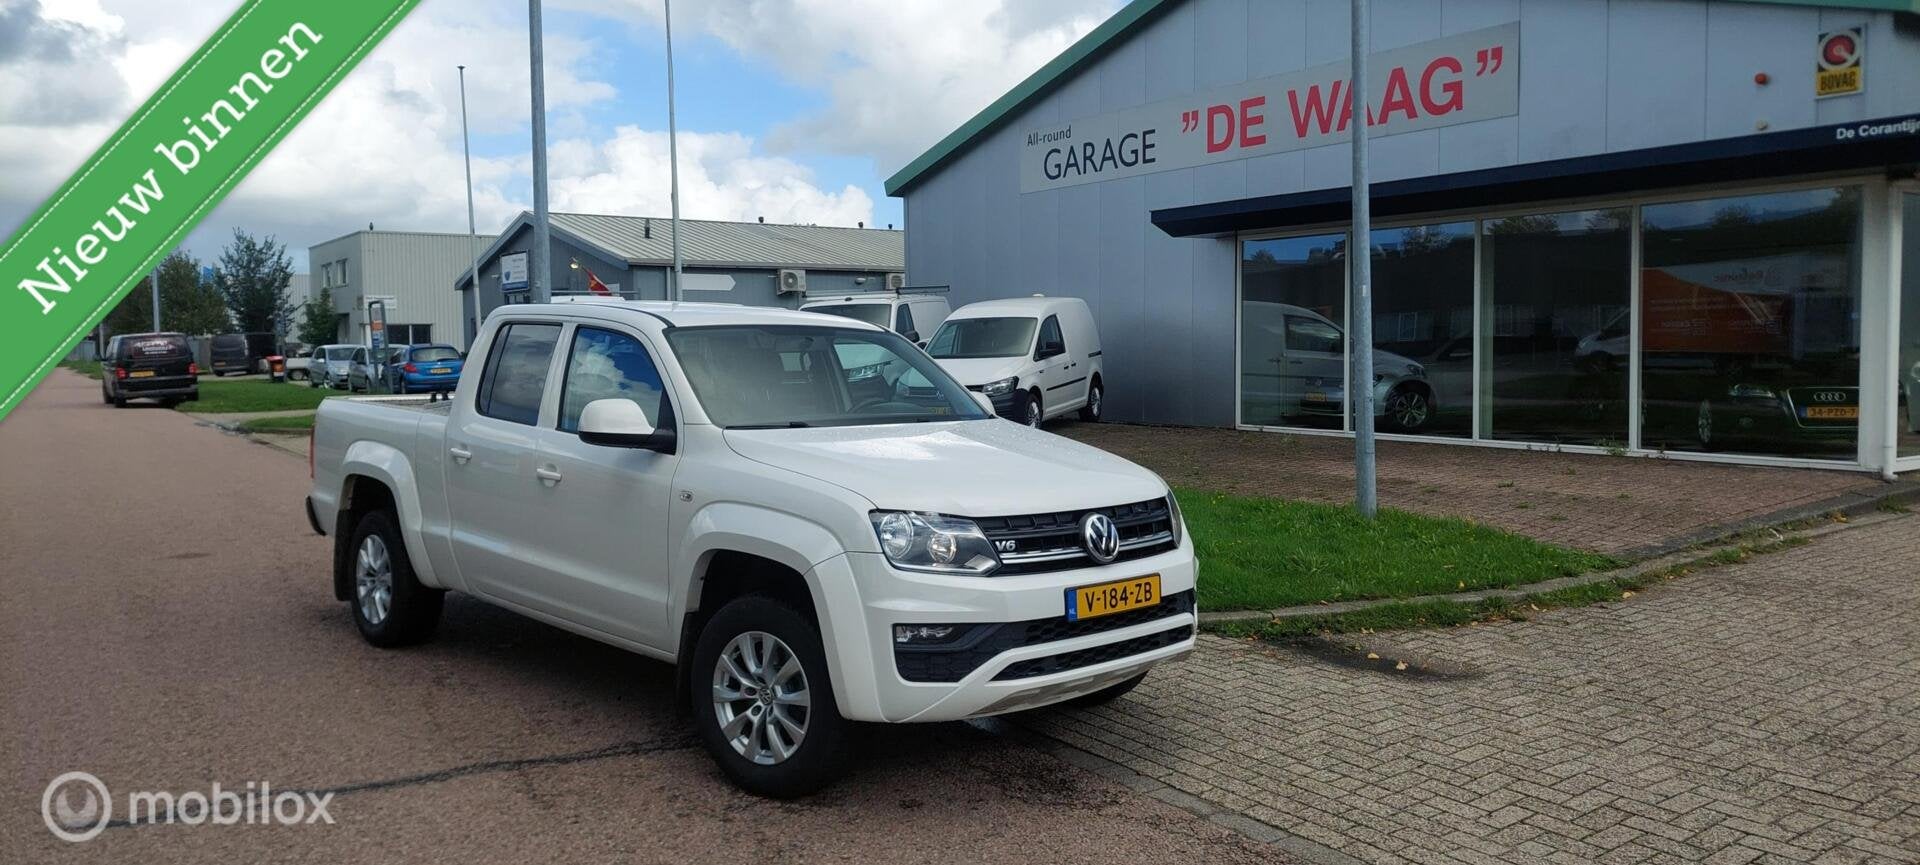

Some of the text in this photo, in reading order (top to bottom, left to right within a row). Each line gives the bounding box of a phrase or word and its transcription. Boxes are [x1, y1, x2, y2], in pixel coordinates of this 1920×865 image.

[1820, 70, 1857, 92] BOVAG
[1027, 125, 1072, 146] All-round
[1836, 128, 1855, 139] De
[1043, 129, 1157, 180] GARAGE
[995, 539, 1016, 551] V6
[1085, 581, 1153, 613] V-184-ZB
